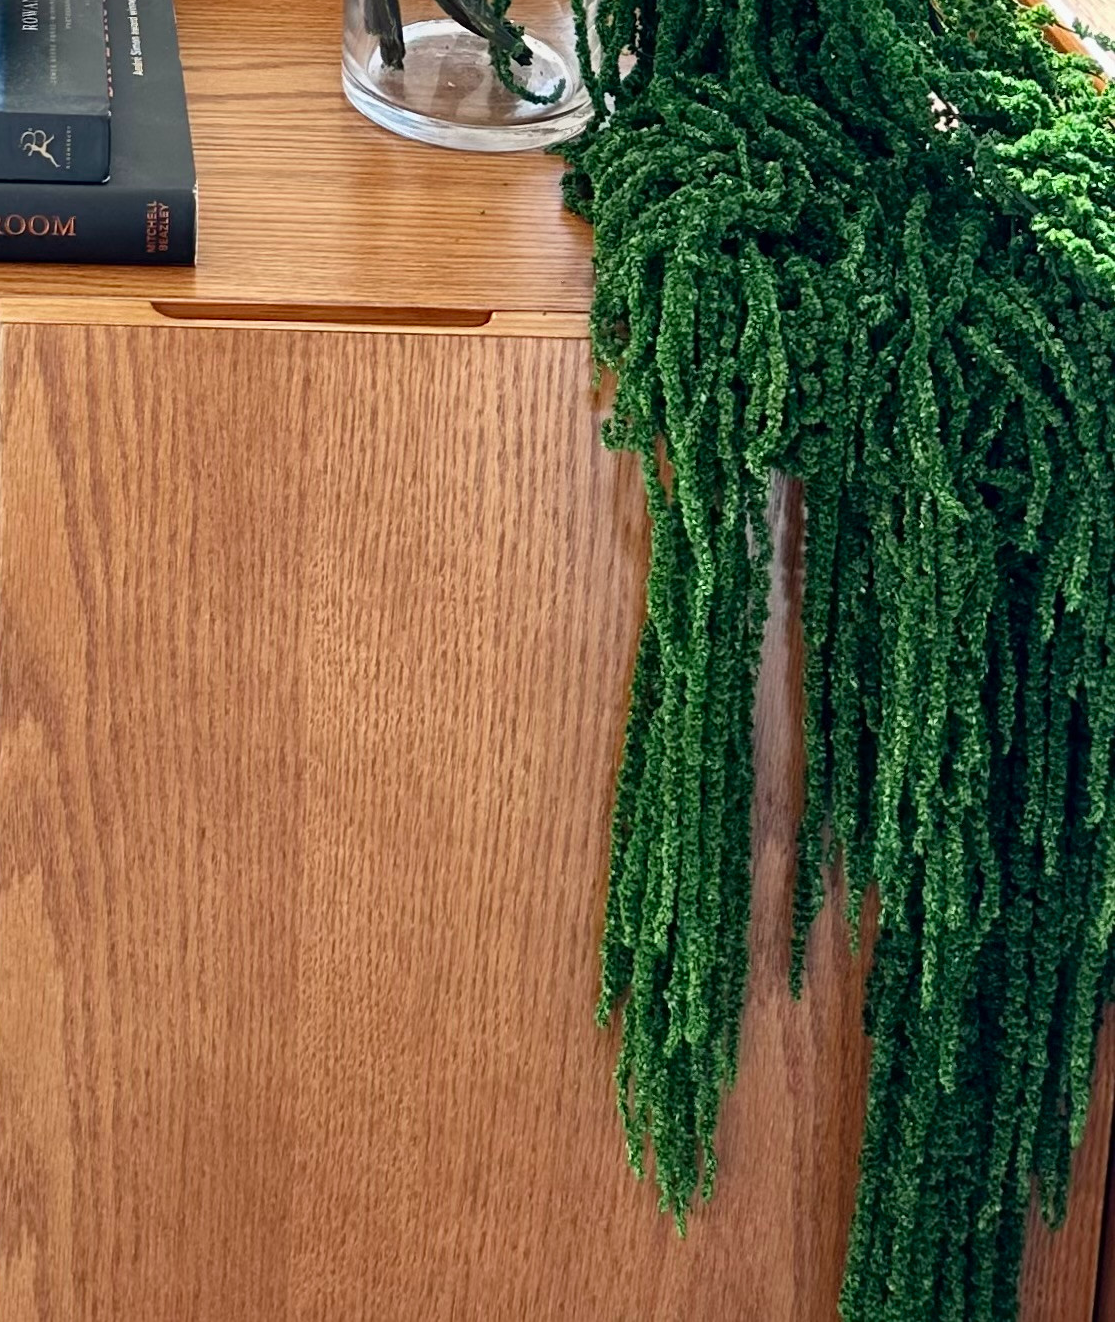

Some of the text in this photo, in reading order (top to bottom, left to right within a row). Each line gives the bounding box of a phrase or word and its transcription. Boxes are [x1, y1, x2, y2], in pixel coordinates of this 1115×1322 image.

[127, 16, 140, 35] award
[146, 201, 157, 253] MITCHELL
[158, 202, 170, 252] BEAZLEY
